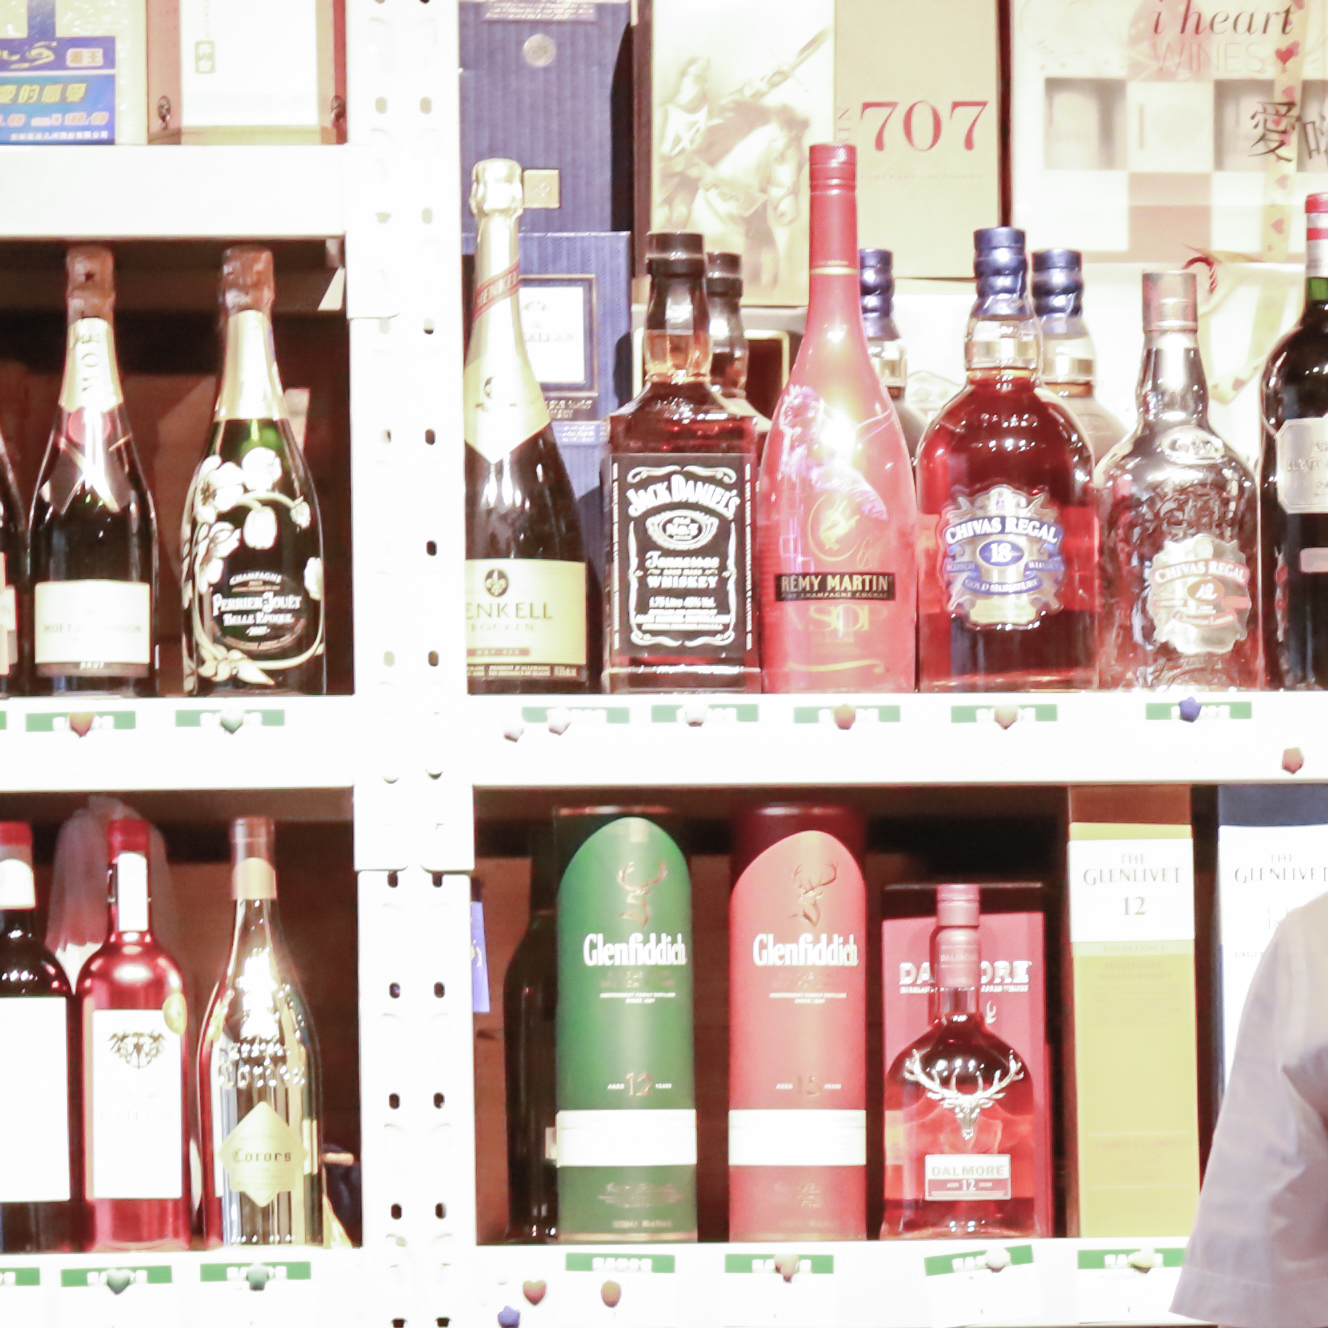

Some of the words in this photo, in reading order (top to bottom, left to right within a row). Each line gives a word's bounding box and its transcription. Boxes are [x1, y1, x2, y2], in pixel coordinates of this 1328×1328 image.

[1180, 0, 1293, 35] heart
[1152, 43, 1264, 72] WINES
[860, 100, 988, 151] 707
[626, 485, 673, 517] JACK
[672, 474, 741, 519] DANIEL'S
[945, 517, 1001, 545] CHIVAS
[1005, 515, 1057, 543] REGAL
[990, 543, 1011, 562] 18
[229, 571, 282, 585] CHAMPAGNE
[1155, 562, 1205, 582] CHIVAS
[1209, 560, 1245, 583] REGAL
[646, 576, 717, 589] WHISKEY
[826, 574, 893, 591] MARTIN
[466, 602, 553, 618] ENKELL
[1083, 868, 1181, 885] GLENLIVET
[1234, 866, 1328, 884] GLENLIVET
[1124, 897, 1147, 915] 12
[583, 933, 687, 966] Glenfiddich
[753, 933, 858, 968] Glenfiddich
[900, 962, 1032, 983] DAORE
[626, 1072, 652, 1096] 12
[932, 1165, 1005, 1176] DALMORE
[961, 1179, 976, 1191] 12
